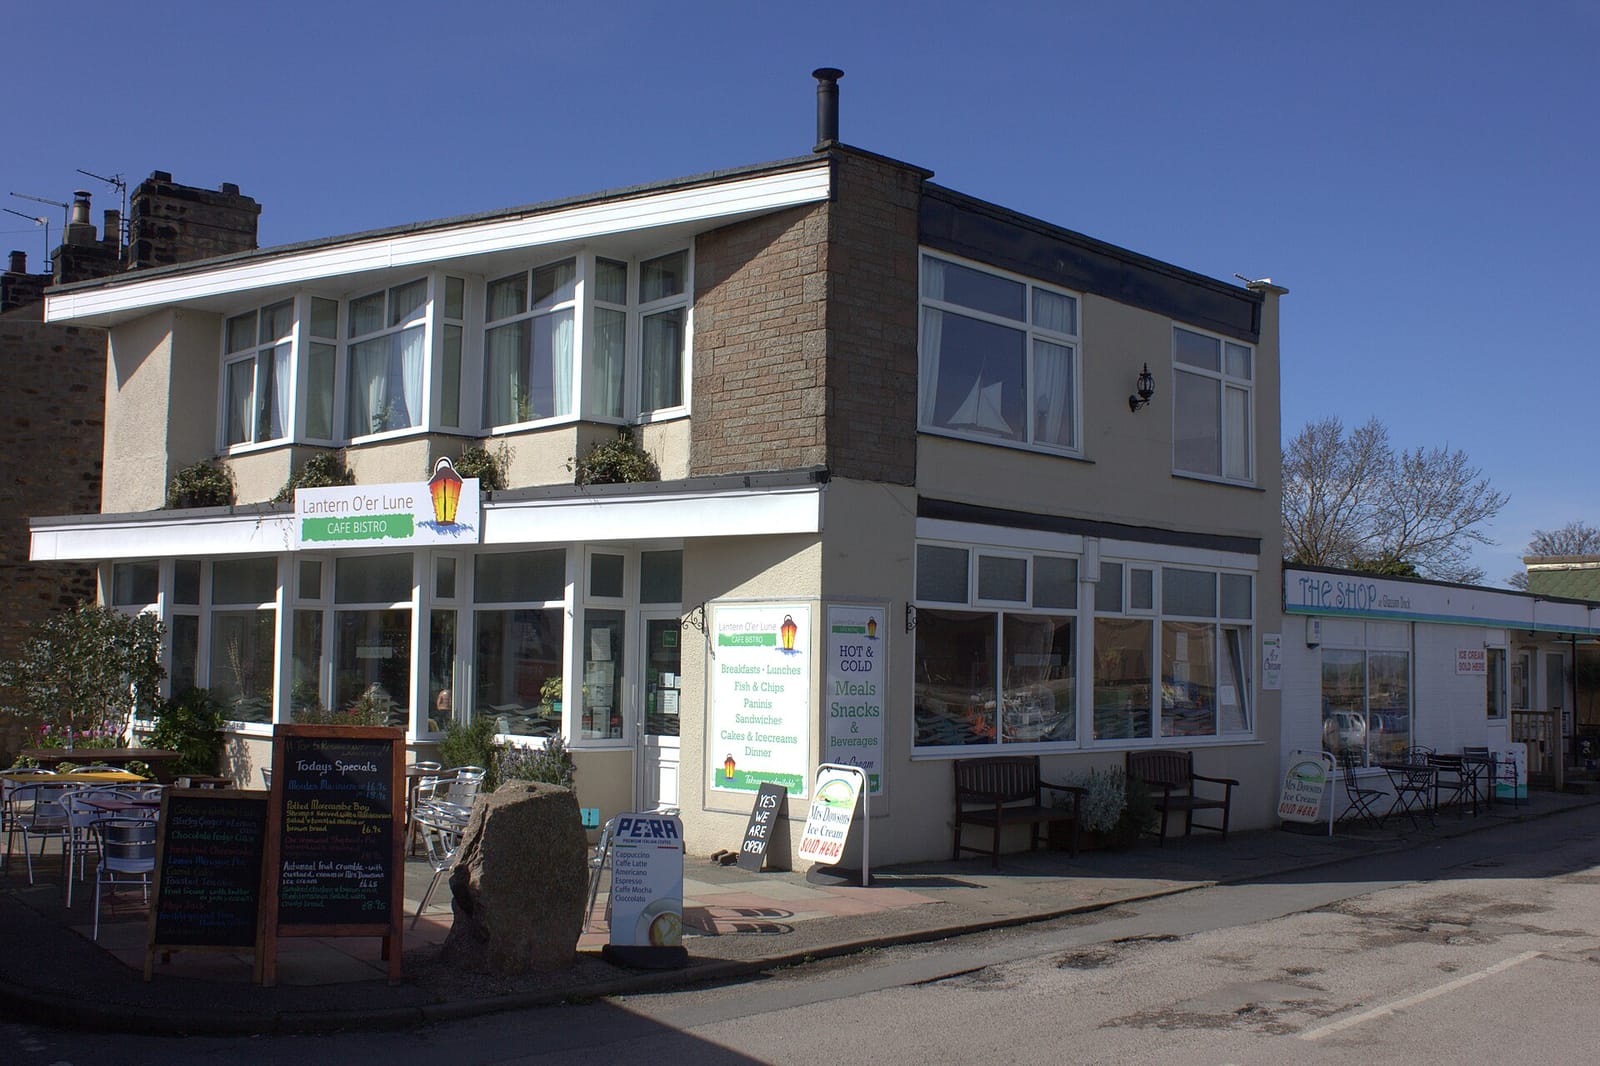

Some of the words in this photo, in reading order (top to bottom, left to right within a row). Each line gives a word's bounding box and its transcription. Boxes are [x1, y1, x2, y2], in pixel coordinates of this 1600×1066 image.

[302, 498, 349, 514] Lantern
[352, 495, 379, 511] O'er
[382, 495, 414, 509] Lune
[327, 522, 351, 535] CAFE
[353, 520, 387, 533] BISTRO
[1299, 576, 1332, 609] THE
[1336, 581, 1376, 610] SHOP
[718, 623, 743, 632] Lantern
[760, 621, 777, 631] Lune
[840, 645, 863, 657] HOT
[866, 646, 874, 657] &
[721, 663, 761, 675] Breakfasts
[766, 664, 801, 675] Lunches
[840, 660, 872, 672] COLD
[1458, 662, 1471, 671] SOLD
[1472, 662, 1485, 671] HERE
[734, 681, 750, 692] Fish
[752, 682, 759, 691] &
[760, 682, 785, 693] Chips
[835, 680, 876, 696] Meals
[743, 698, 772, 709] Paninis
[831, 702, 880, 718] Snacks
[735, 714, 783, 725] Sandwiches
[850, 721, 858, 733] &
[720, 730, 745, 741] Cakes
[746, 731, 754, 741] &
[755, 732, 798, 744] Icecreams
[831, 735, 878, 748] Beverages
[745, 746, 771, 758] Dinner
[296, 760, 332, 776] Todays
[335, 760, 377, 776] Specials
[760, 794, 777, 808] YES
[1283, 792, 1294, 801] Ice
[1295, 794, 1317, 804] Cream
[287, 800, 309, 810] Potted
[353, 802, 371, 812] Bay
[810, 805, 823, 819] Mrs
[1280, 802, 1296, 814] SOLD
[1296, 803, 1318, 817] HERE
[755, 811, 770, 823] WE
[748, 825, 767, 838] ARE
[807, 823, 819, 835] Ice
[820, 825, 844, 839] Cream
[743, 840, 765, 855] OPEN
[800, 837, 820, 853] SOLD
[820, 840, 842, 858] HERE
[615, 851, 650, 860] Cappuccino
[632, 860, 647, 868] Latte
[615, 868, 647, 876] Americano
[615, 877, 642, 886] Espresso
[632, 886, 652, 894] Mocha
